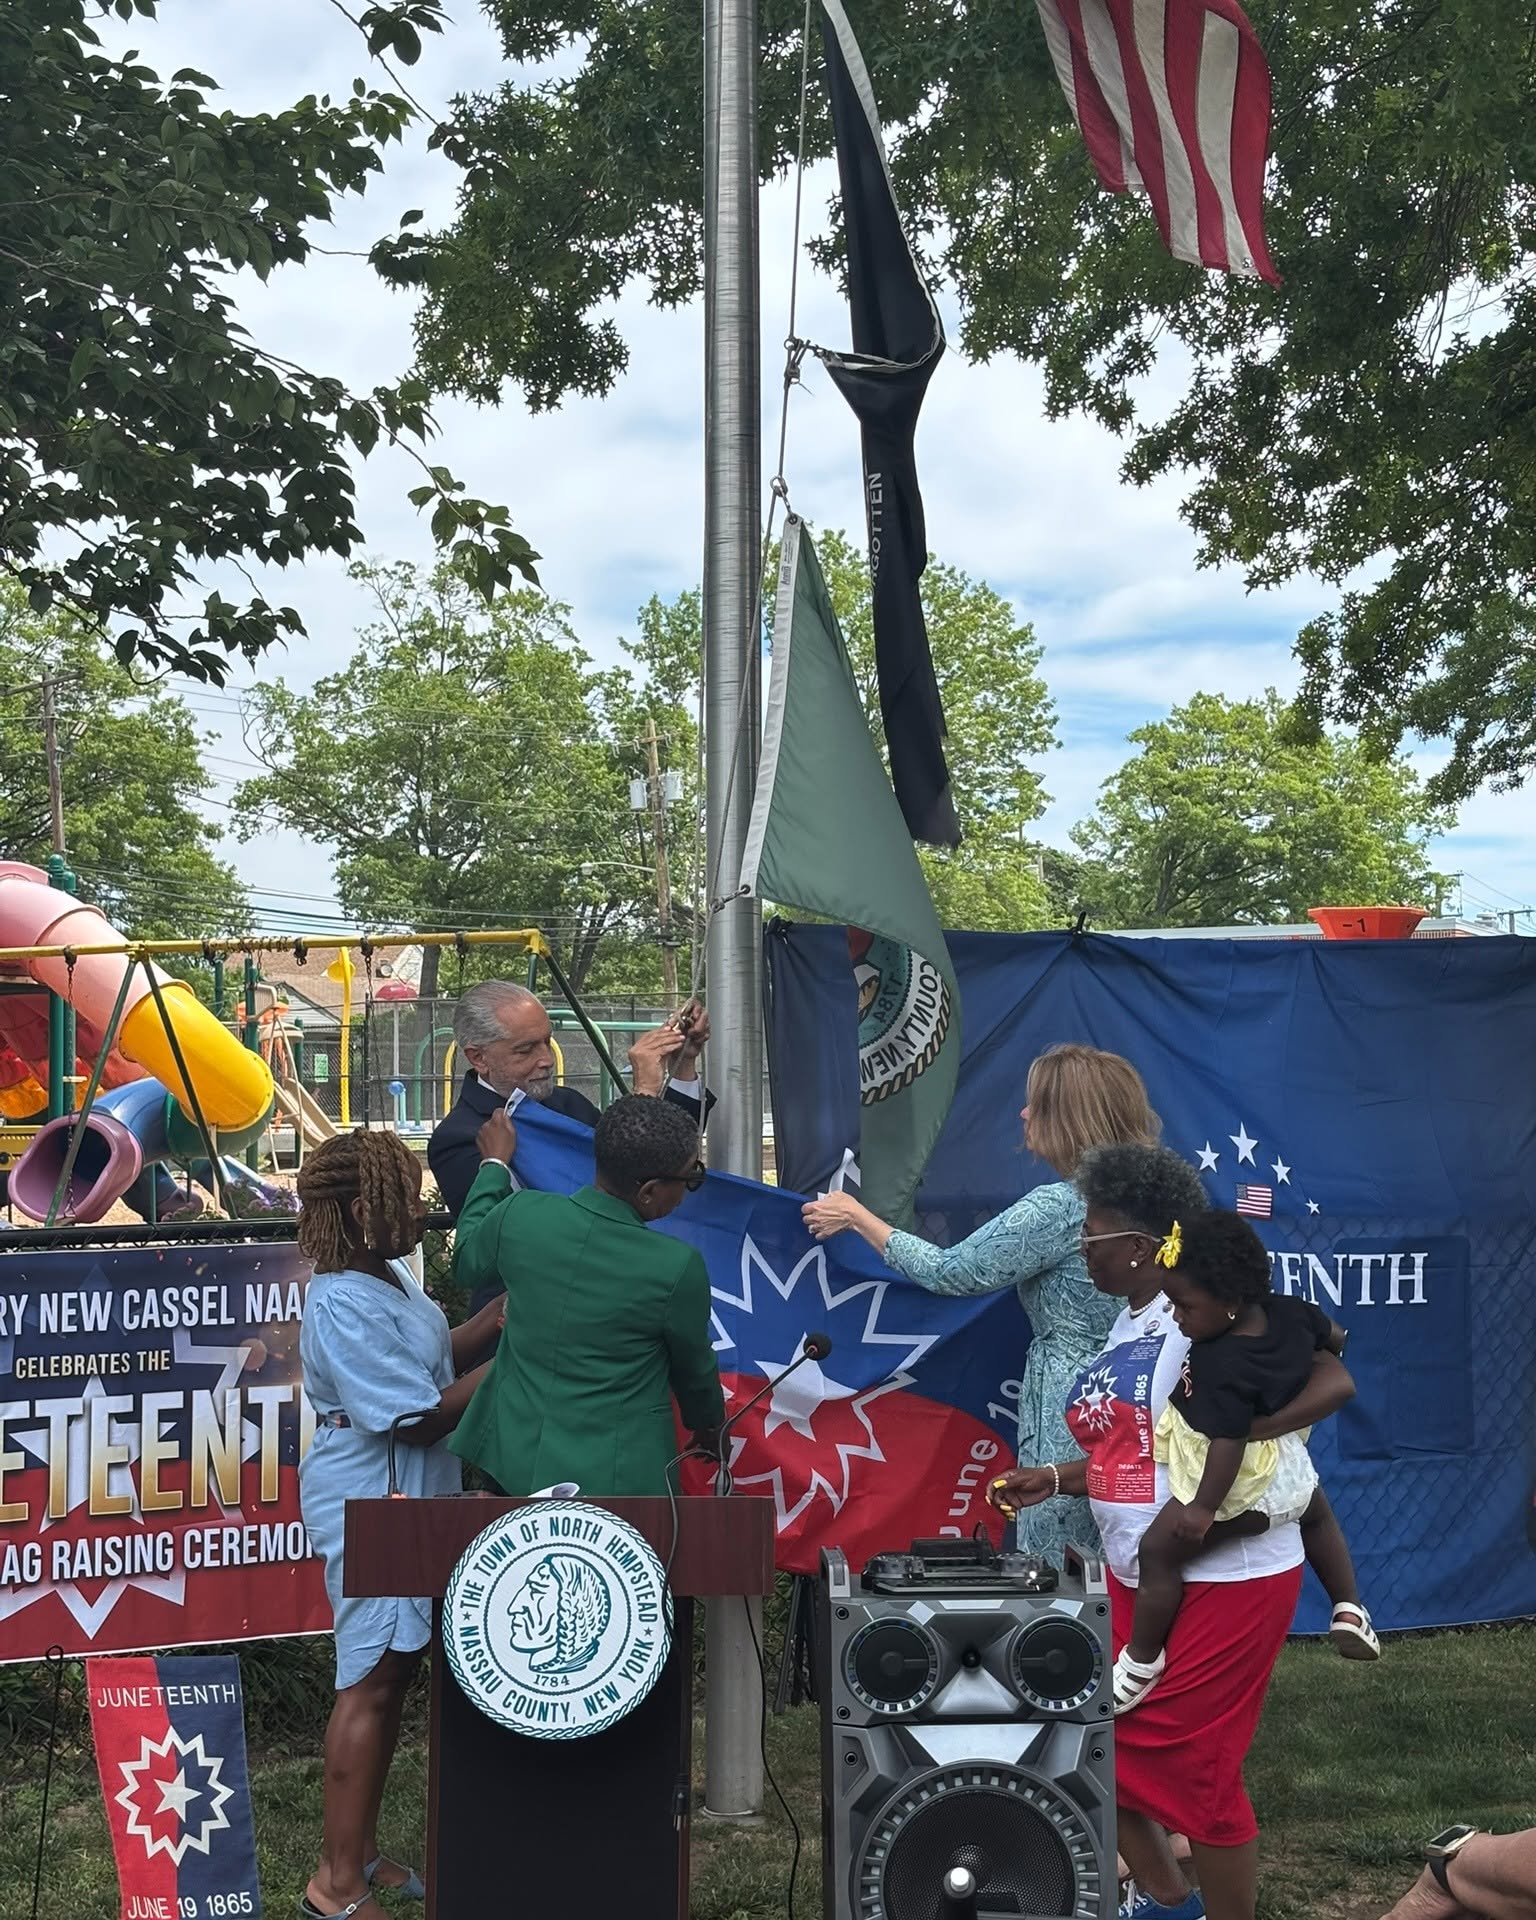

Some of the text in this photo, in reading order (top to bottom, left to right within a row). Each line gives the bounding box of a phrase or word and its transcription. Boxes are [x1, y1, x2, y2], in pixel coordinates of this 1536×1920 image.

[40, 1291, 113, 1335] NEW
[123, 1284, 236, 1331] CASSEL
[245, 1280, 311, 1323] NAA
[15, 1349, 171, 1380] CELEBRATES THE
[1134, 1374, 1149, 1402] 1865
[1138, 1427, 1152, 1457] June
[52, 1531, 174, 1582] RAISING
[460, 1516, 659, 1624] THE TOWN OF NORTH HEMPSTEAD
[459, 1625, 655, 1725] NASSAU COUNTY, NEW YORK
[533, 1674, 571, 1688] 1784
[97, 1683, 237, 1708] JUNETEENTH
[127, 1891, 254, 1919] JUNE 19 1865
